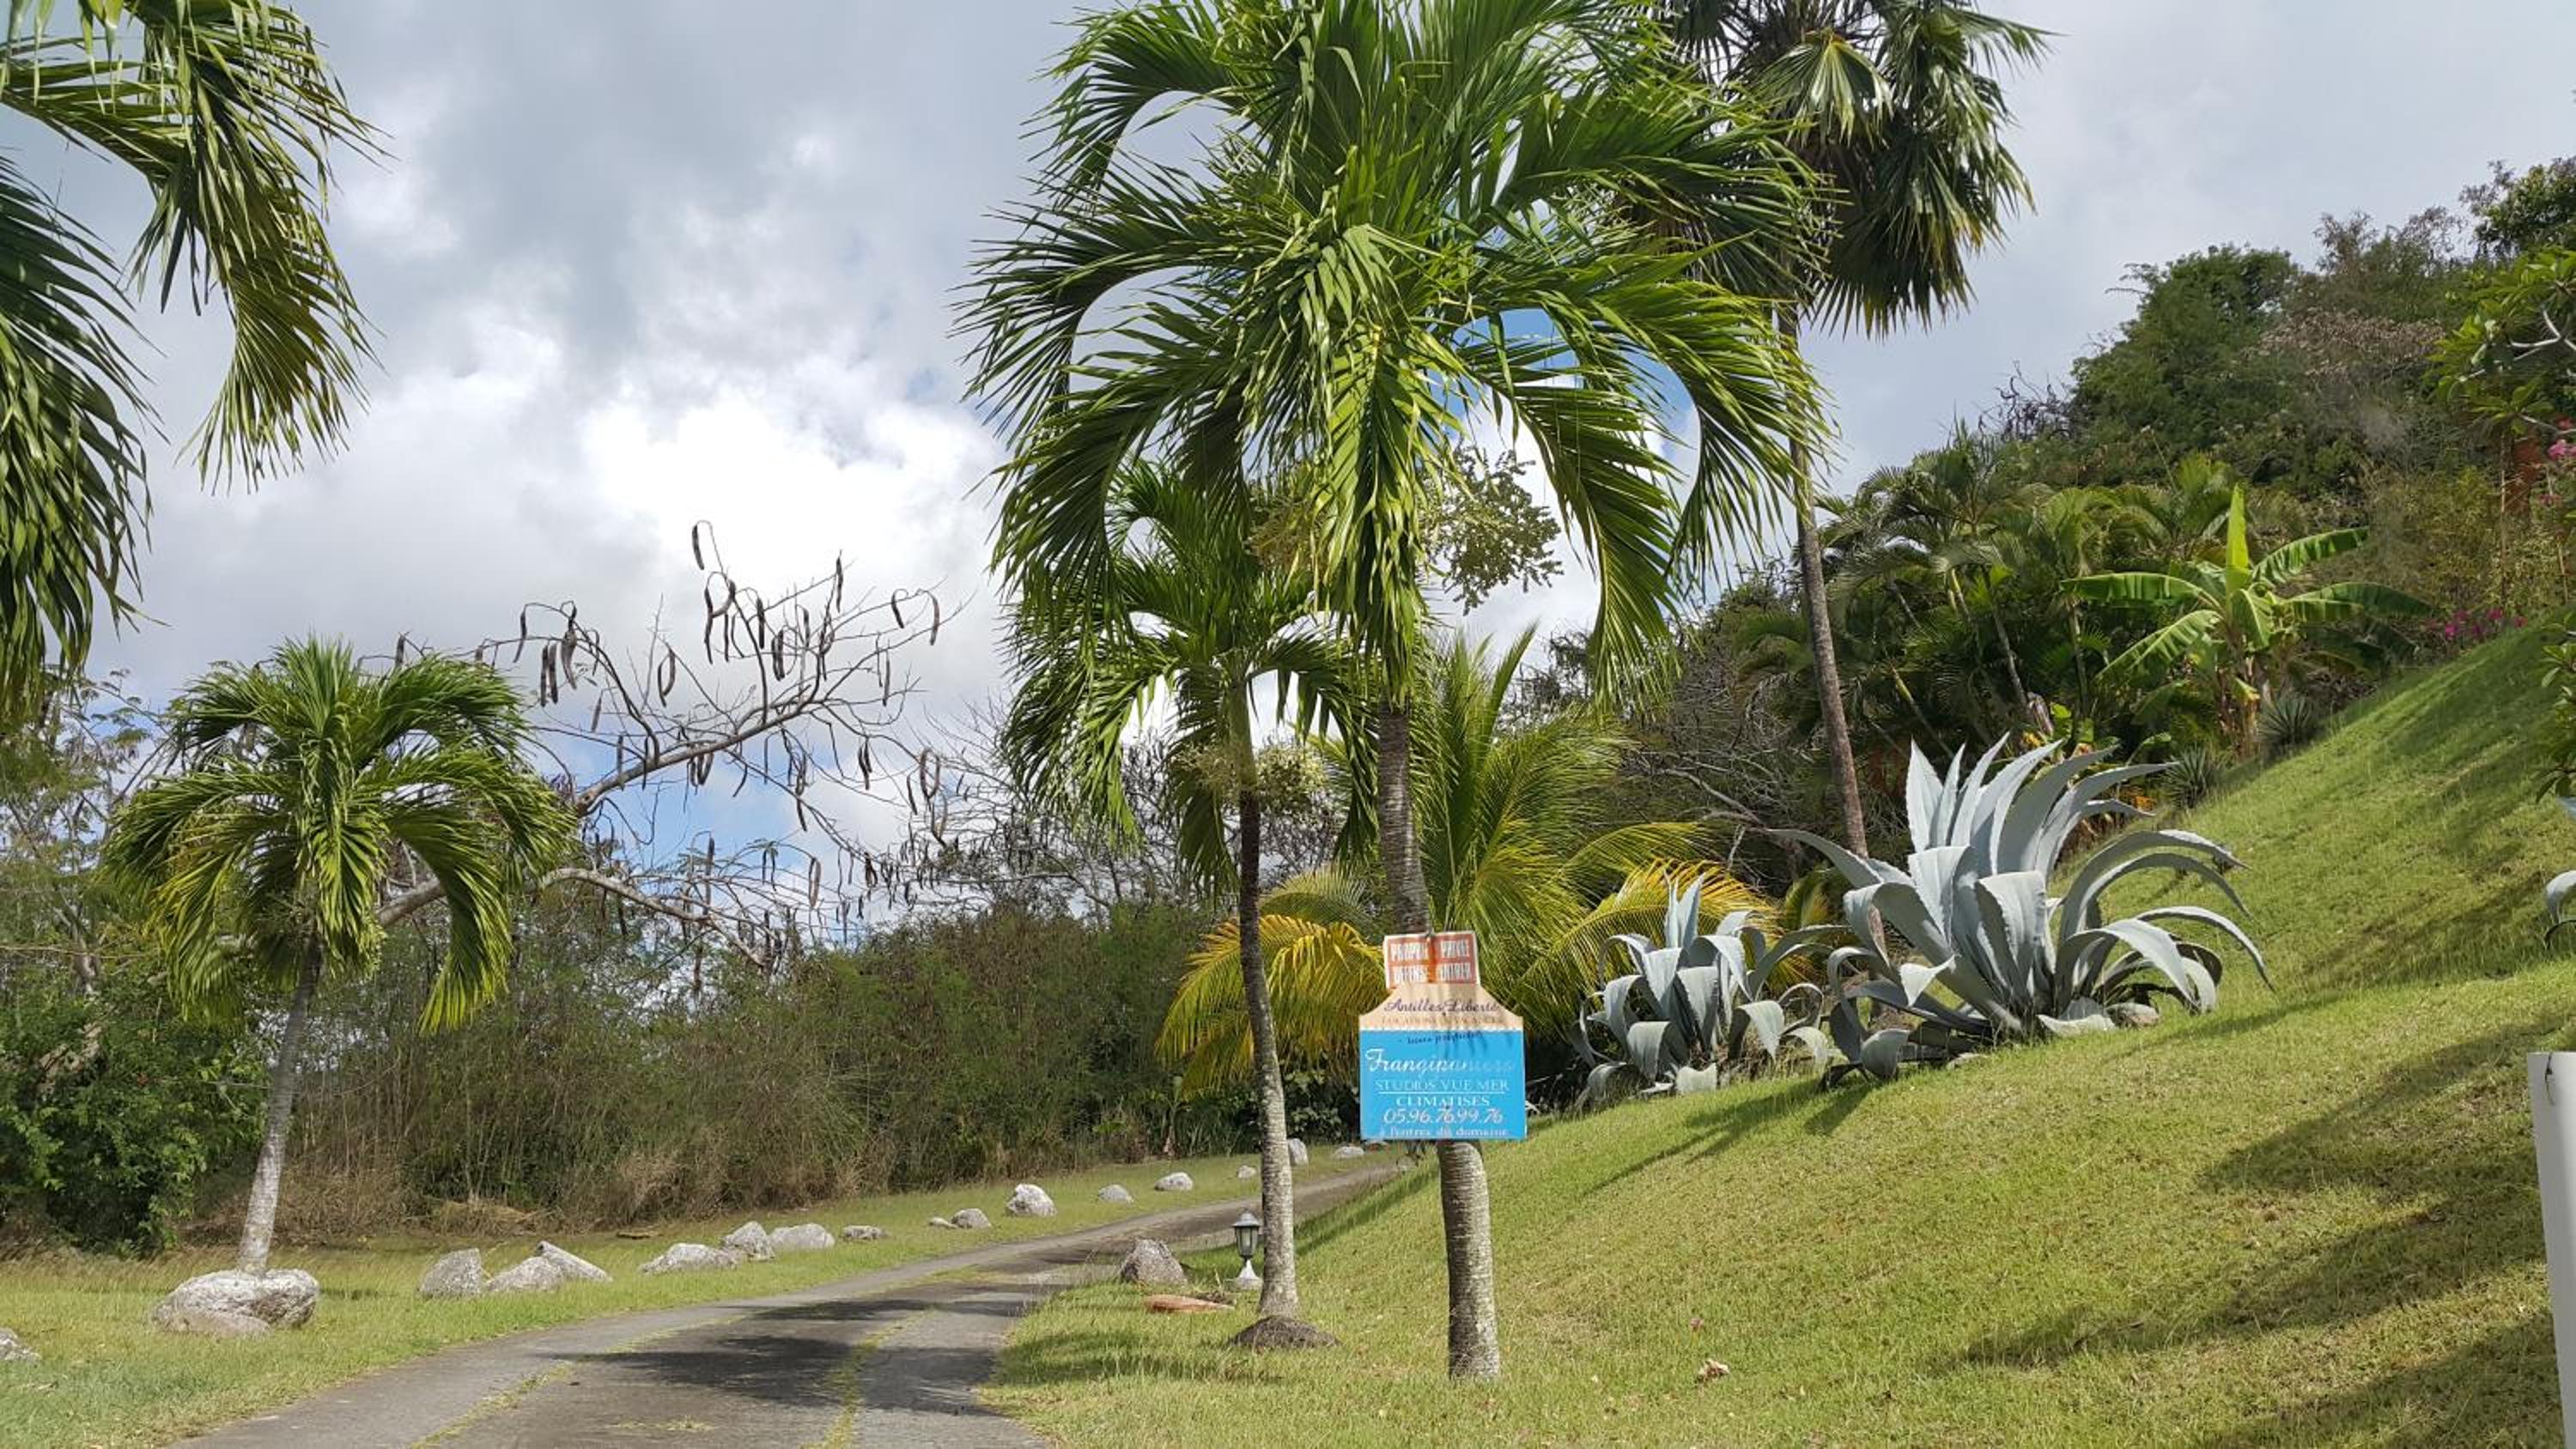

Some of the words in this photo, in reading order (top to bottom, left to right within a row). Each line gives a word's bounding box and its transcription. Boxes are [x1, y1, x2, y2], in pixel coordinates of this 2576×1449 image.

[1383, 997, 1443, 1013] Antilles
[1444, 998, 1500, 1013] Liberté
[1374, 1079, 1437, 1091] STUDIOS
[1442, 1078, 1473, 1091] VUE
[1478, 1078, 1510, 1092] MER
[1395, 1094, 1491, 1107] CLIMATISES
